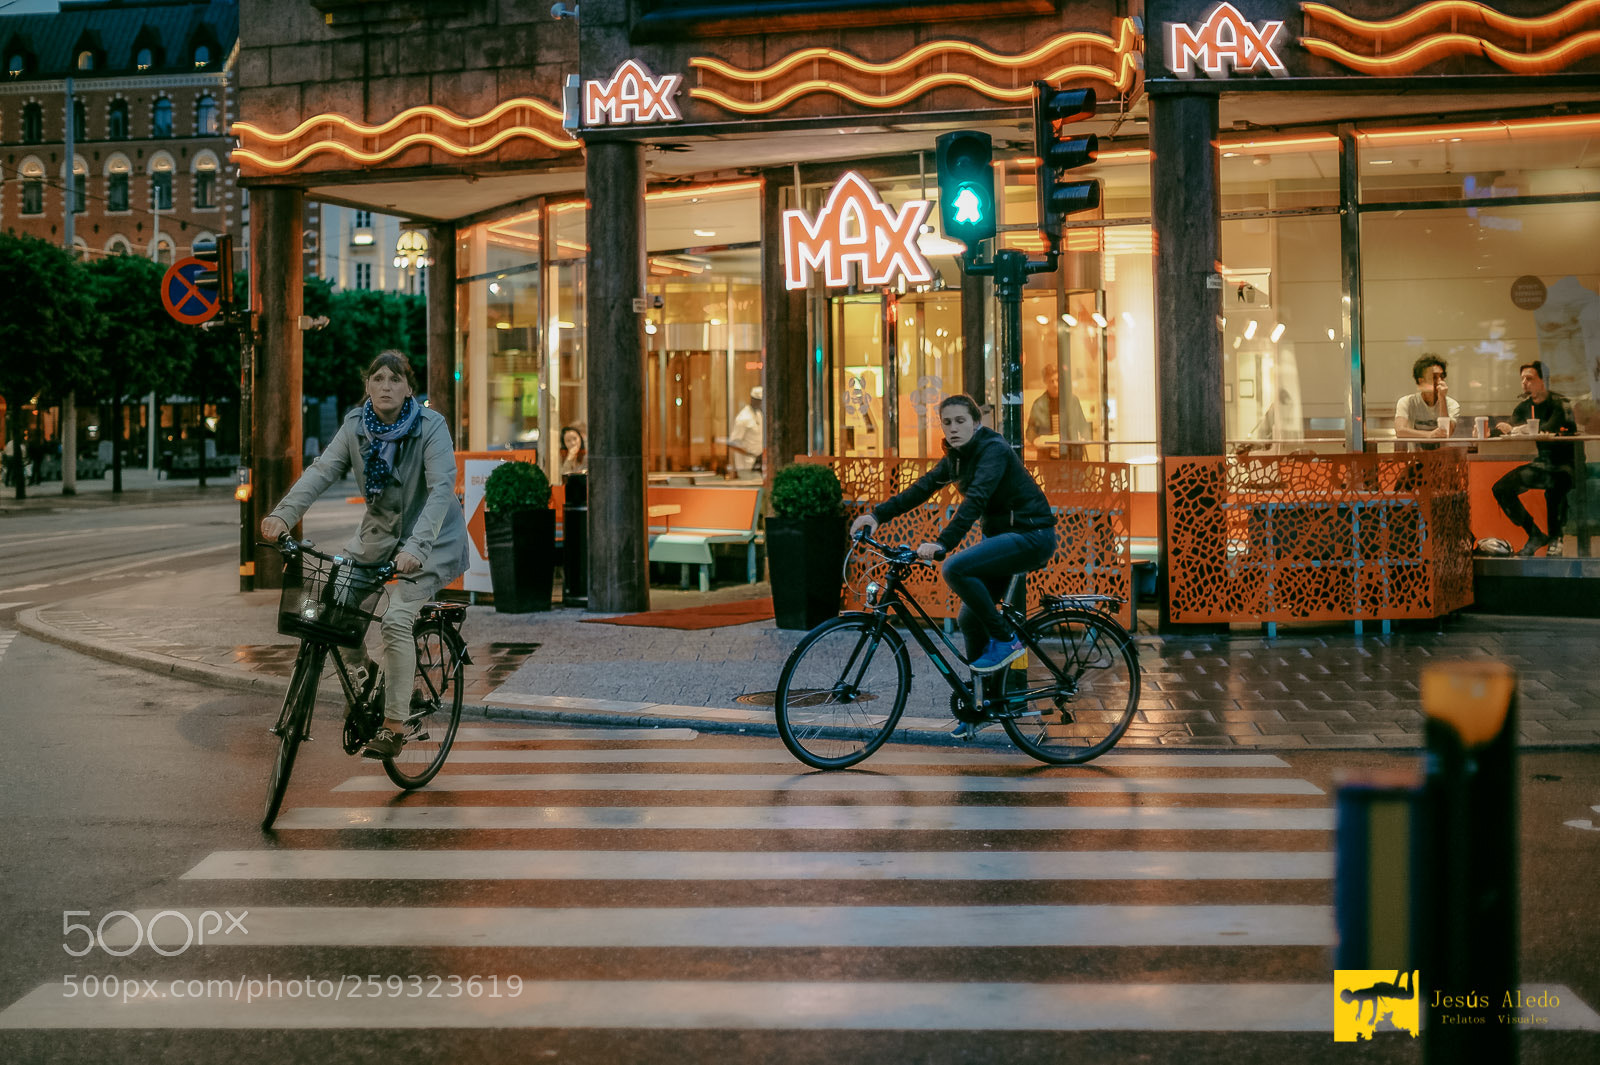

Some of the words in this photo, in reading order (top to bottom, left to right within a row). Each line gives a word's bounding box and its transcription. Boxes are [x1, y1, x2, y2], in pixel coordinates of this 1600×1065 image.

[1171, 2, 1284, 73] MAX
[586, 60, 677, 124] MAX
[783, 171, 931, 290] MAX
